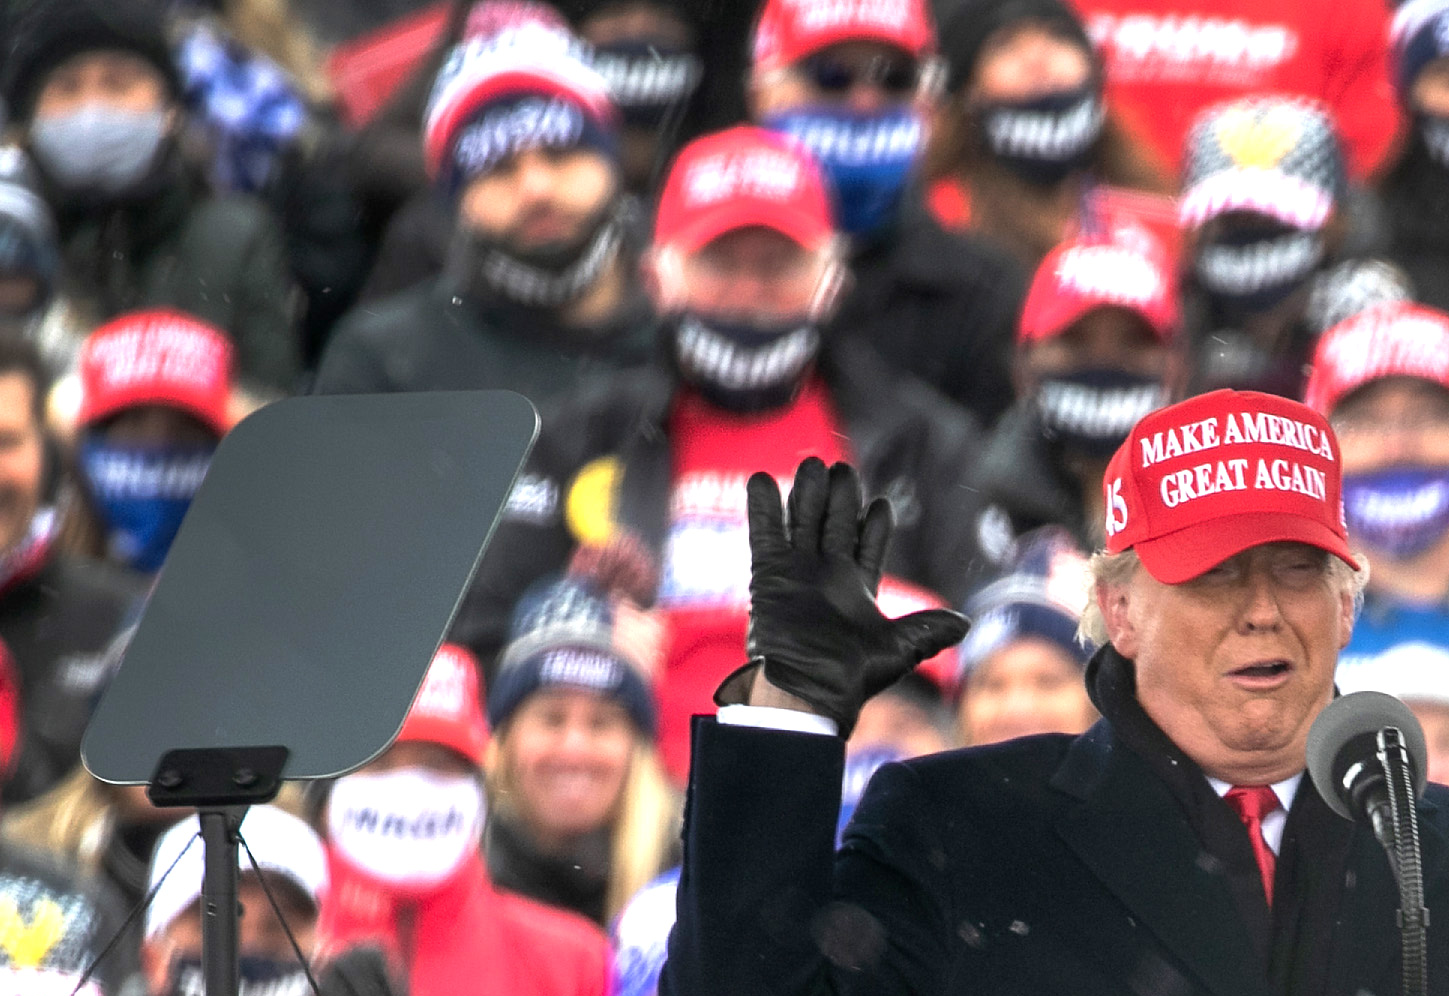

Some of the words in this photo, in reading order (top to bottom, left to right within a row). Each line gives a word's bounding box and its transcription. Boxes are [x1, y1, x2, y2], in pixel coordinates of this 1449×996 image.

[1140, 417, 1220, 467] MAKE
[1224, 412, 1334, 461] AMERICA
[1160, 459, 1248, 507] GREAT
[1255, 459, 1326, 502] AGAIN
